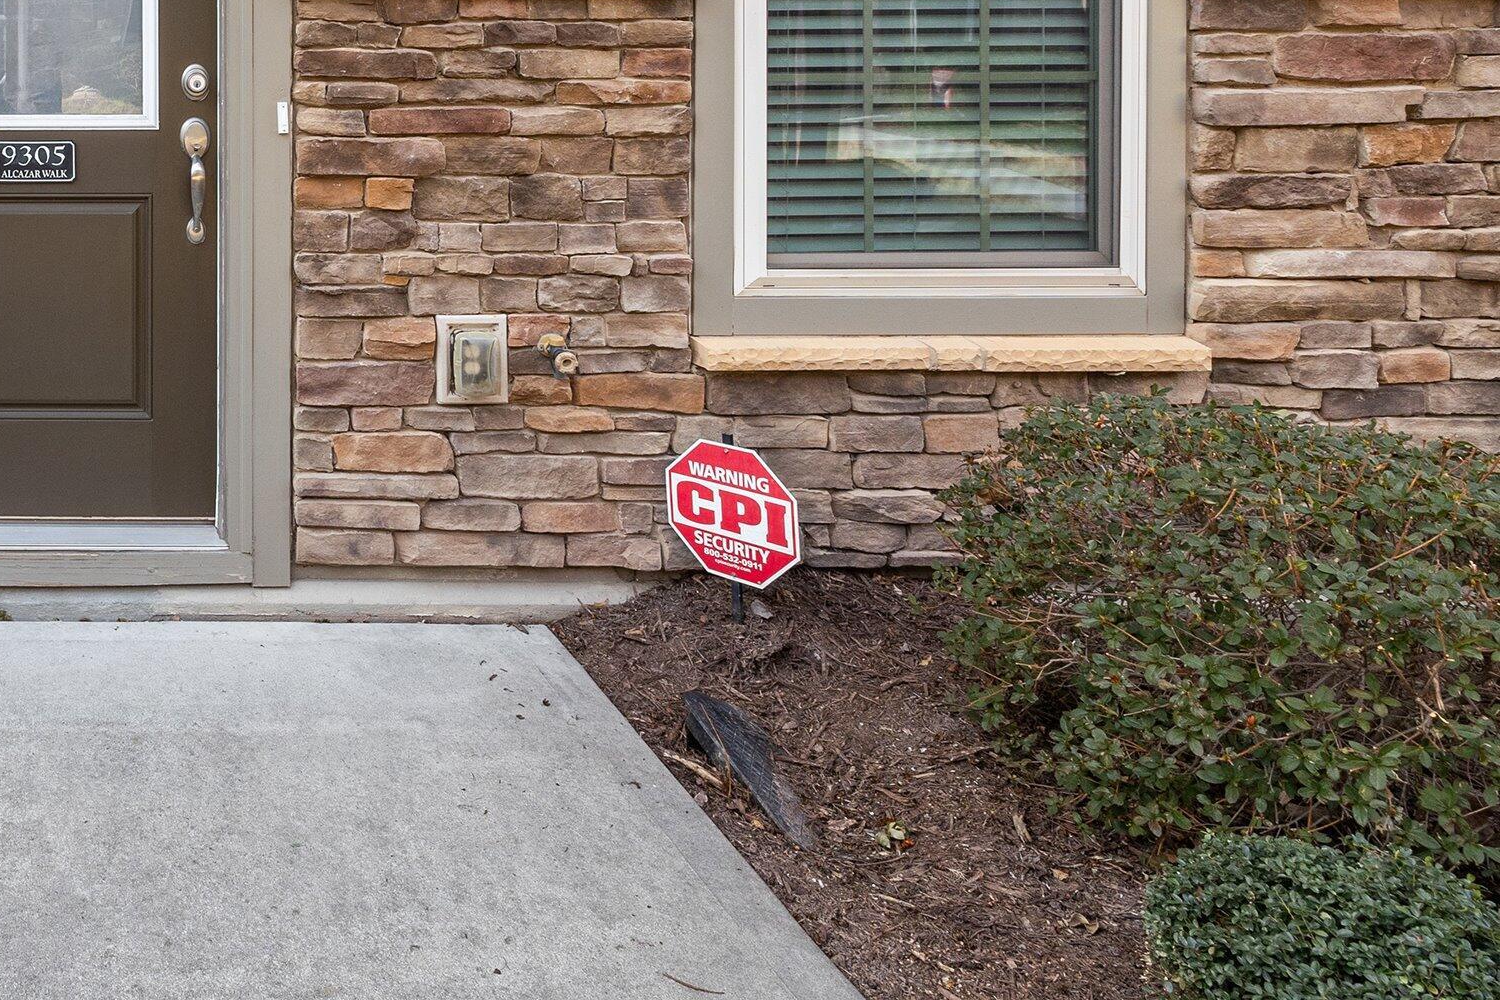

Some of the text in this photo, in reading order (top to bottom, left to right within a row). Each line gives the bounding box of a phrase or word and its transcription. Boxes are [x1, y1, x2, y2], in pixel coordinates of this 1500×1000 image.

[2, 146, 66, 166] 9305
[2, 169, 67, 178] ALCAZAR WALK
[688, 460, 770, 493] WARNING
[676, 480, 788, 548] CPI
[694, 530, 770, 564] SECURITY
[703, 547, 763, 571] 800-532-0911
